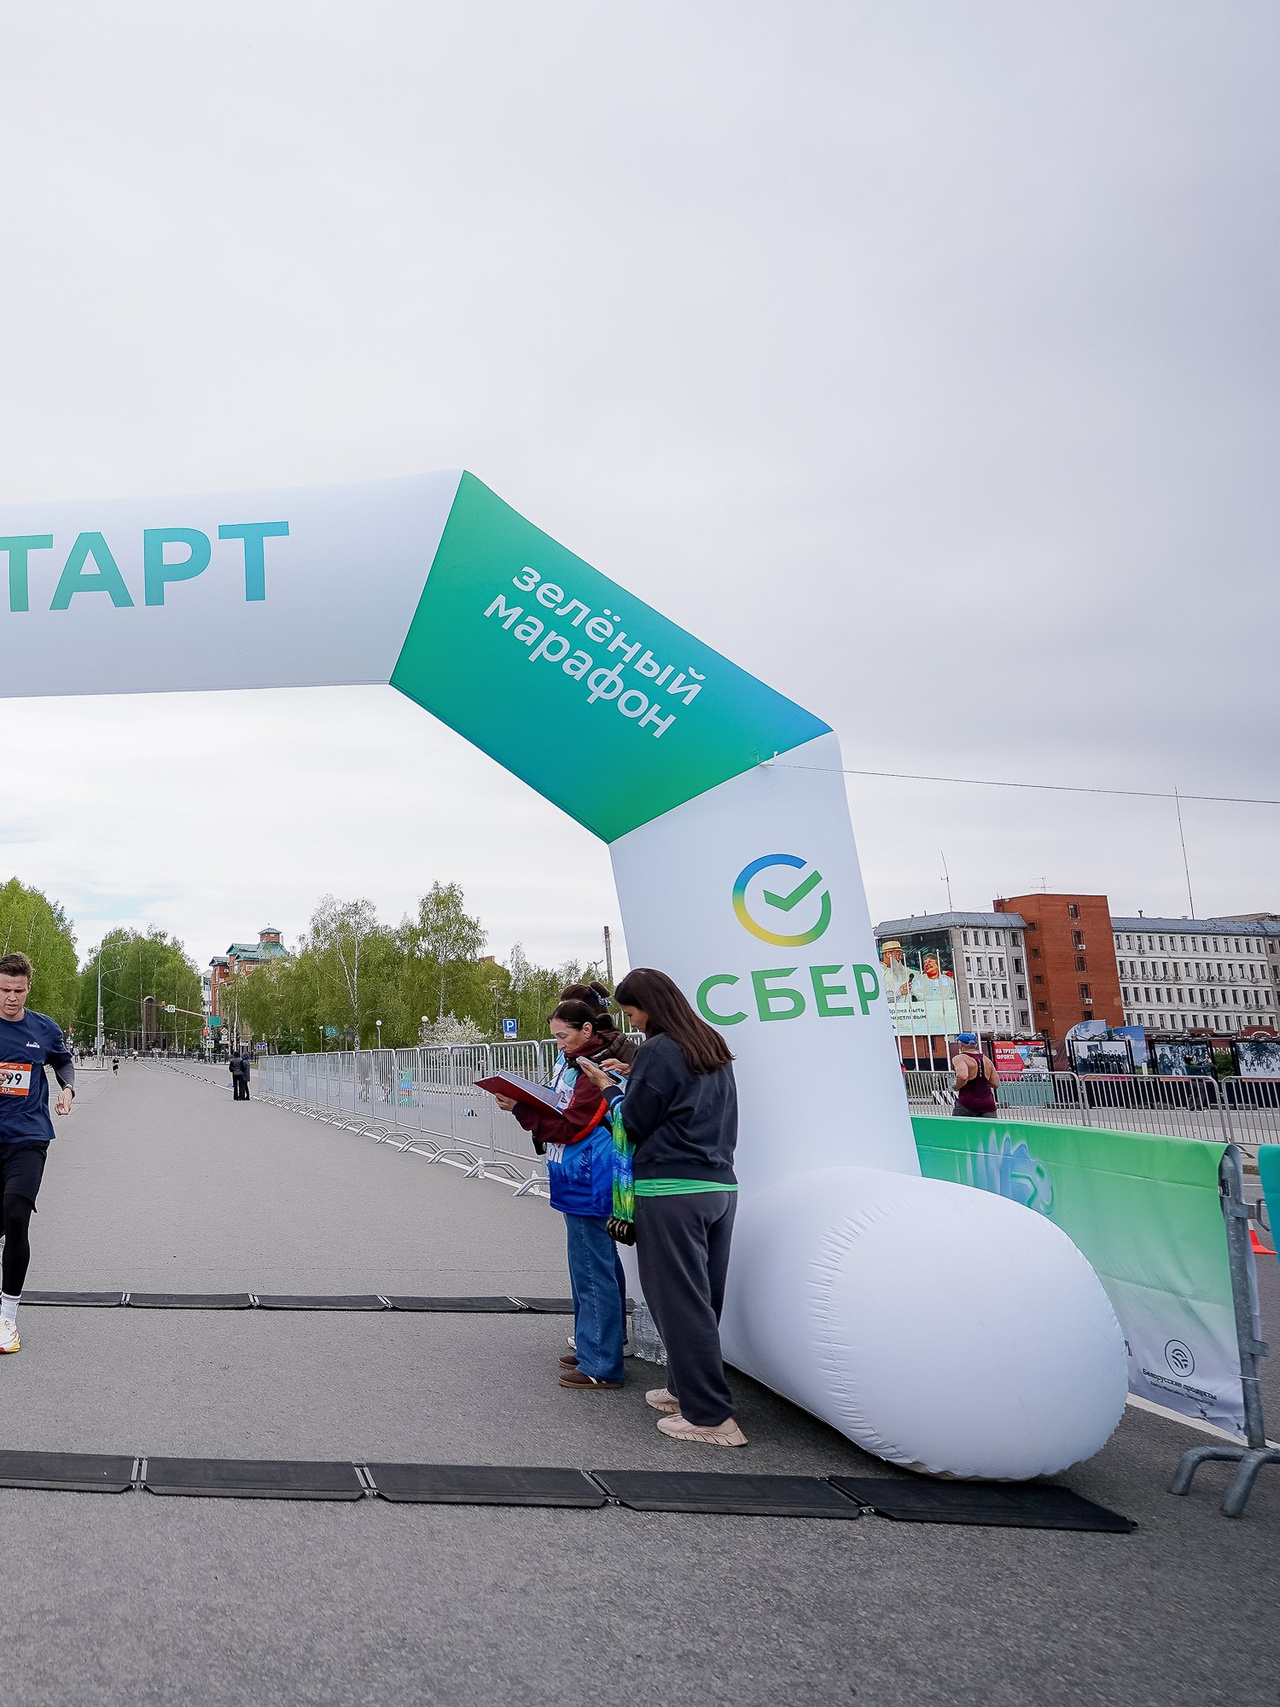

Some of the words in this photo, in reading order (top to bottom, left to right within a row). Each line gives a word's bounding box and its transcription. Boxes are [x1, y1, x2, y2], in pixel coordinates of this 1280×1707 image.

[483, 594, 677, 739] марафон
[512, 566, 707, 706] зелёный
[506, 1020, 515, 1031] P
[696, 963, 880, 1026] СБЕР
[2, 1072, 22, 1085] 99
